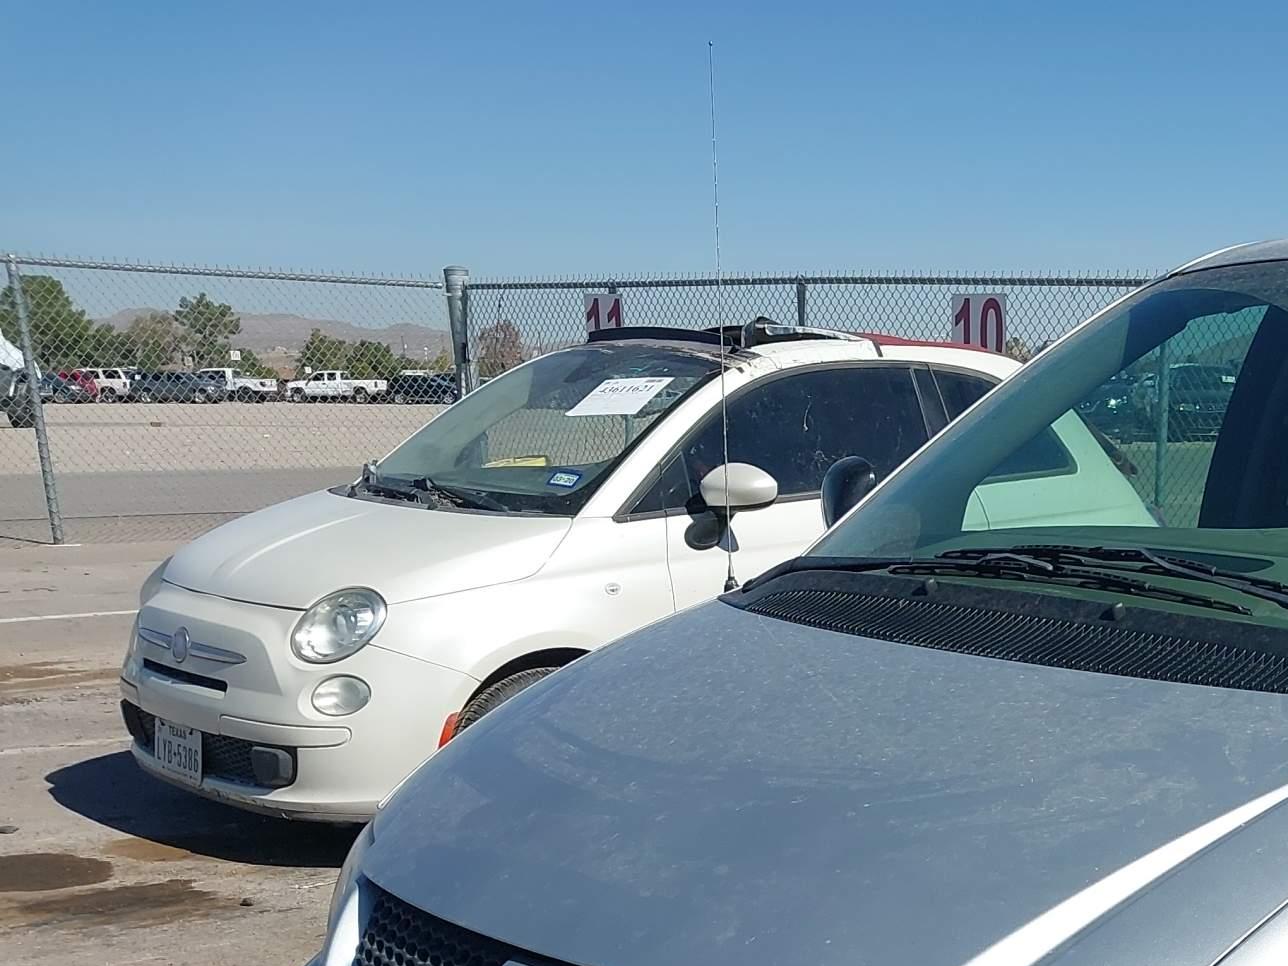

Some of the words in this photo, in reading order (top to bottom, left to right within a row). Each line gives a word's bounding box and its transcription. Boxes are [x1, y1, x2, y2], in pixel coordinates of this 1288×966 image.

[586, 297, 622, 330] 11
[954, 297, 1004, 353] 10
[168, 725, 187, 740] TEXAS
